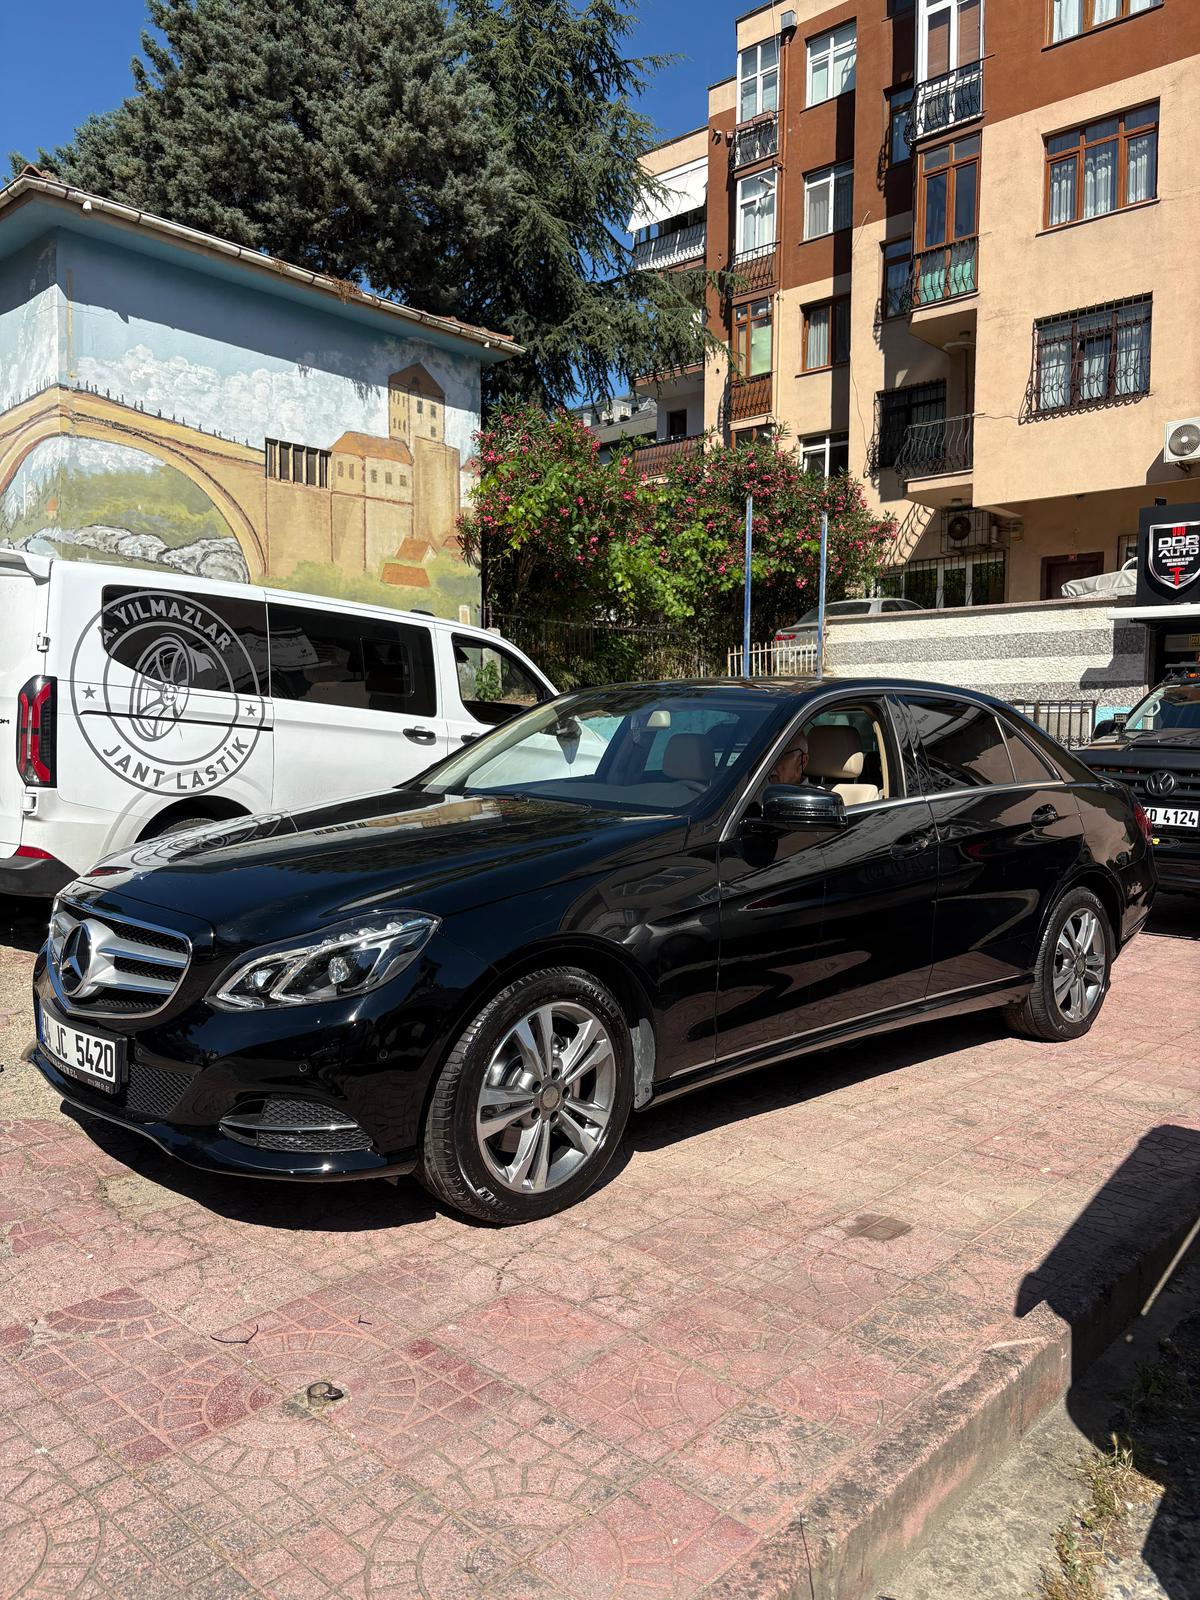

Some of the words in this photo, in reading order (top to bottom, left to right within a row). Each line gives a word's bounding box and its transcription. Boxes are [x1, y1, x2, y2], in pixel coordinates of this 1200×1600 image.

[1158, 534, 1200, 548] DDR
[1158, 547, 1200, 558] AUTO
[114, 599, 232, 651] YILMAZLAR
[103, 744, 165, 787] JANT
[176, 736, 249, 790] LASTİK
[1163, 809, 1196, 825] 4124
[56, 1025, 68, 1060] JC
[75, 1034, 114, 1078] 5420
